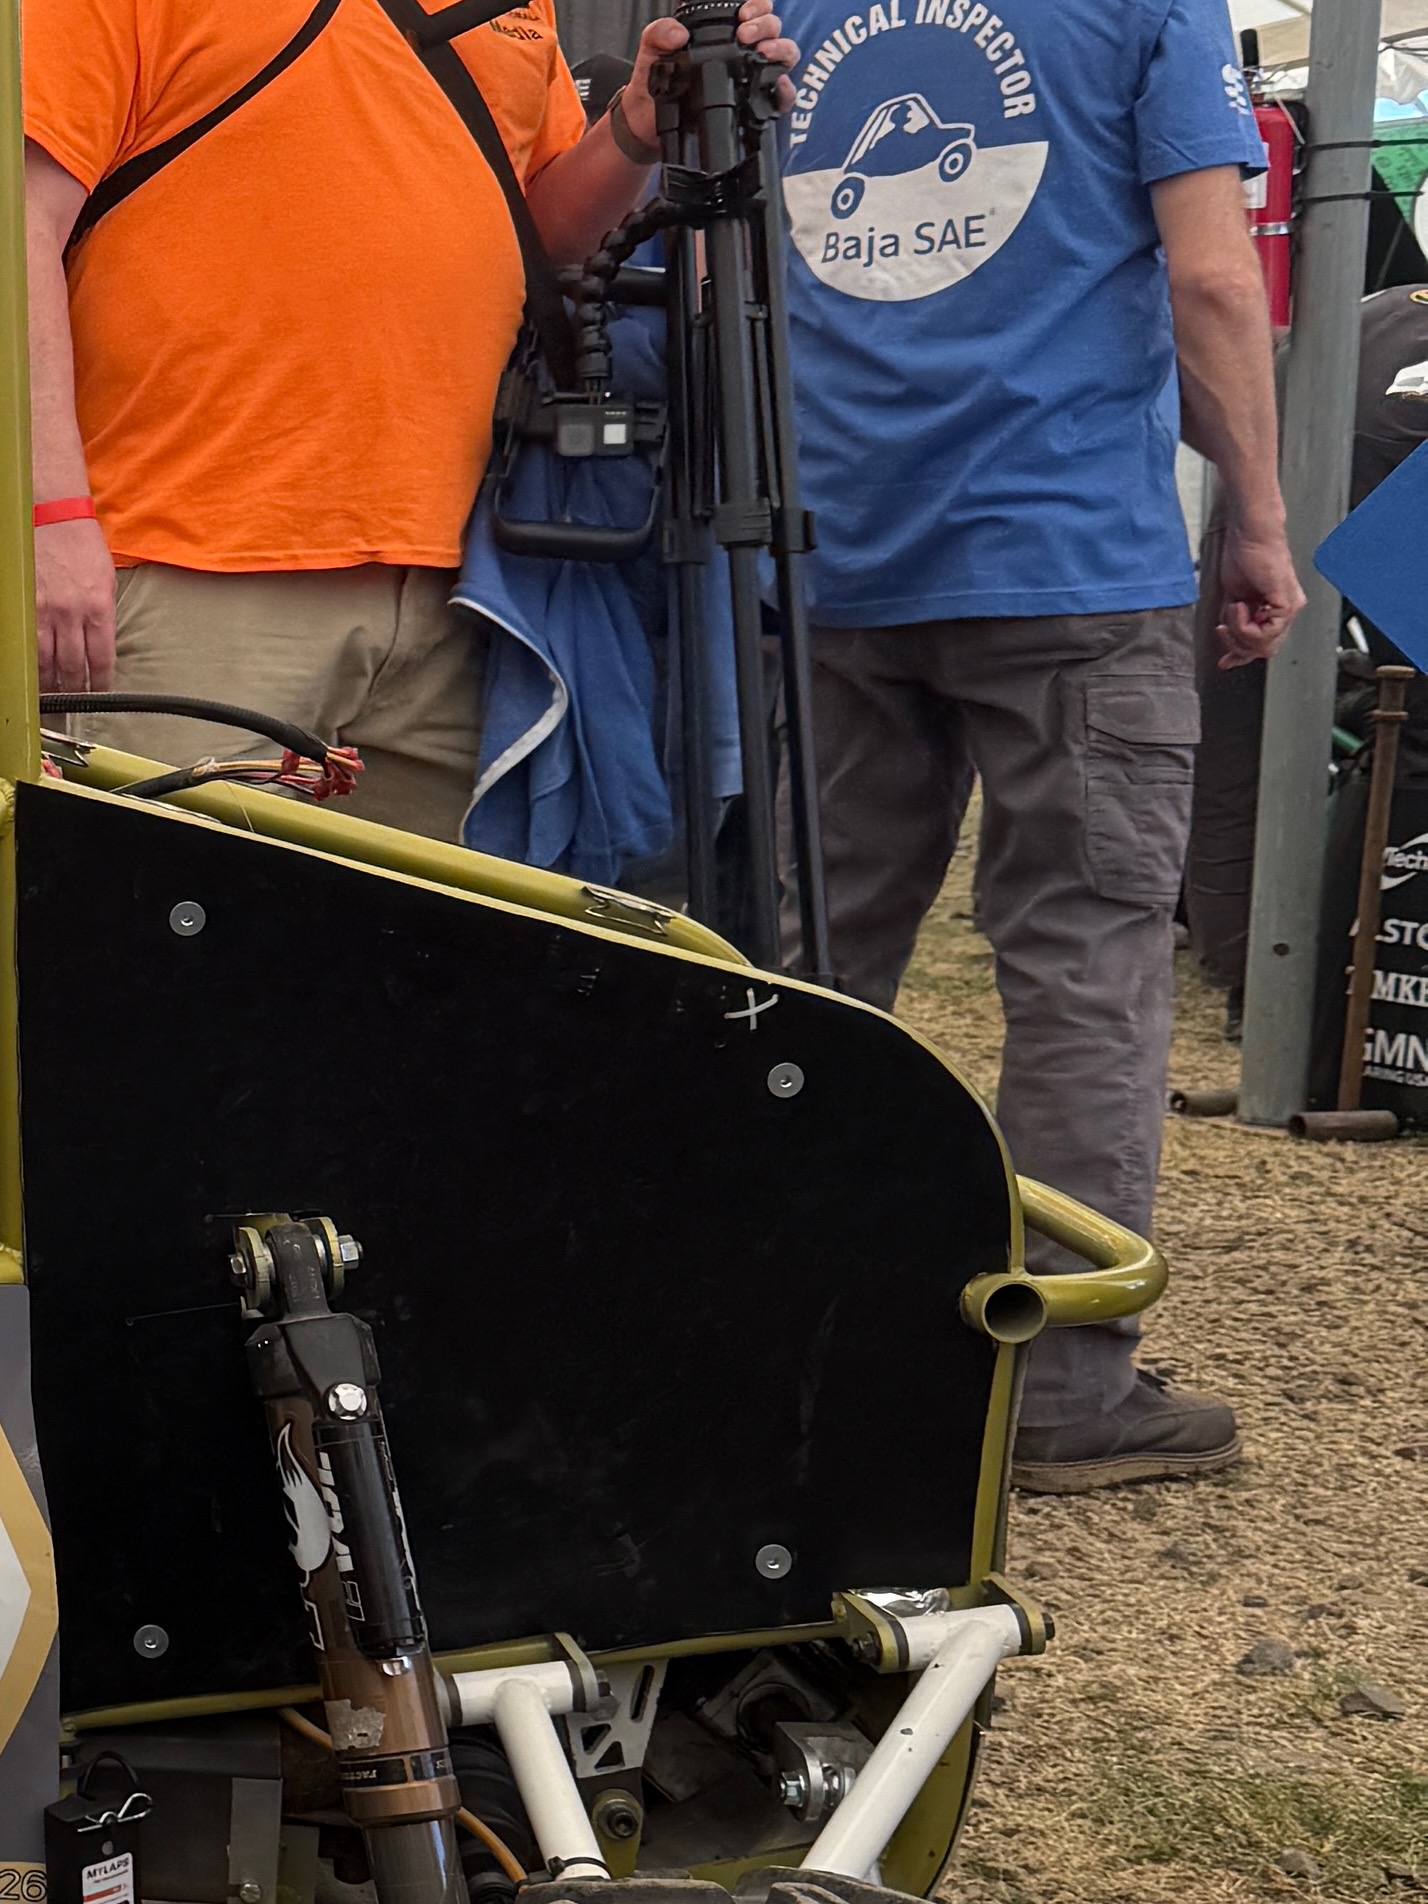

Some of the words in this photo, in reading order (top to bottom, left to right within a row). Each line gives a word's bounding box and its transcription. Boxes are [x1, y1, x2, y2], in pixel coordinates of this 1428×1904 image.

[821, 227, 900, 267] Baja
[913, 214, 987, 254] SAE
[86, 1857, 130, 1880] MYLAPS
